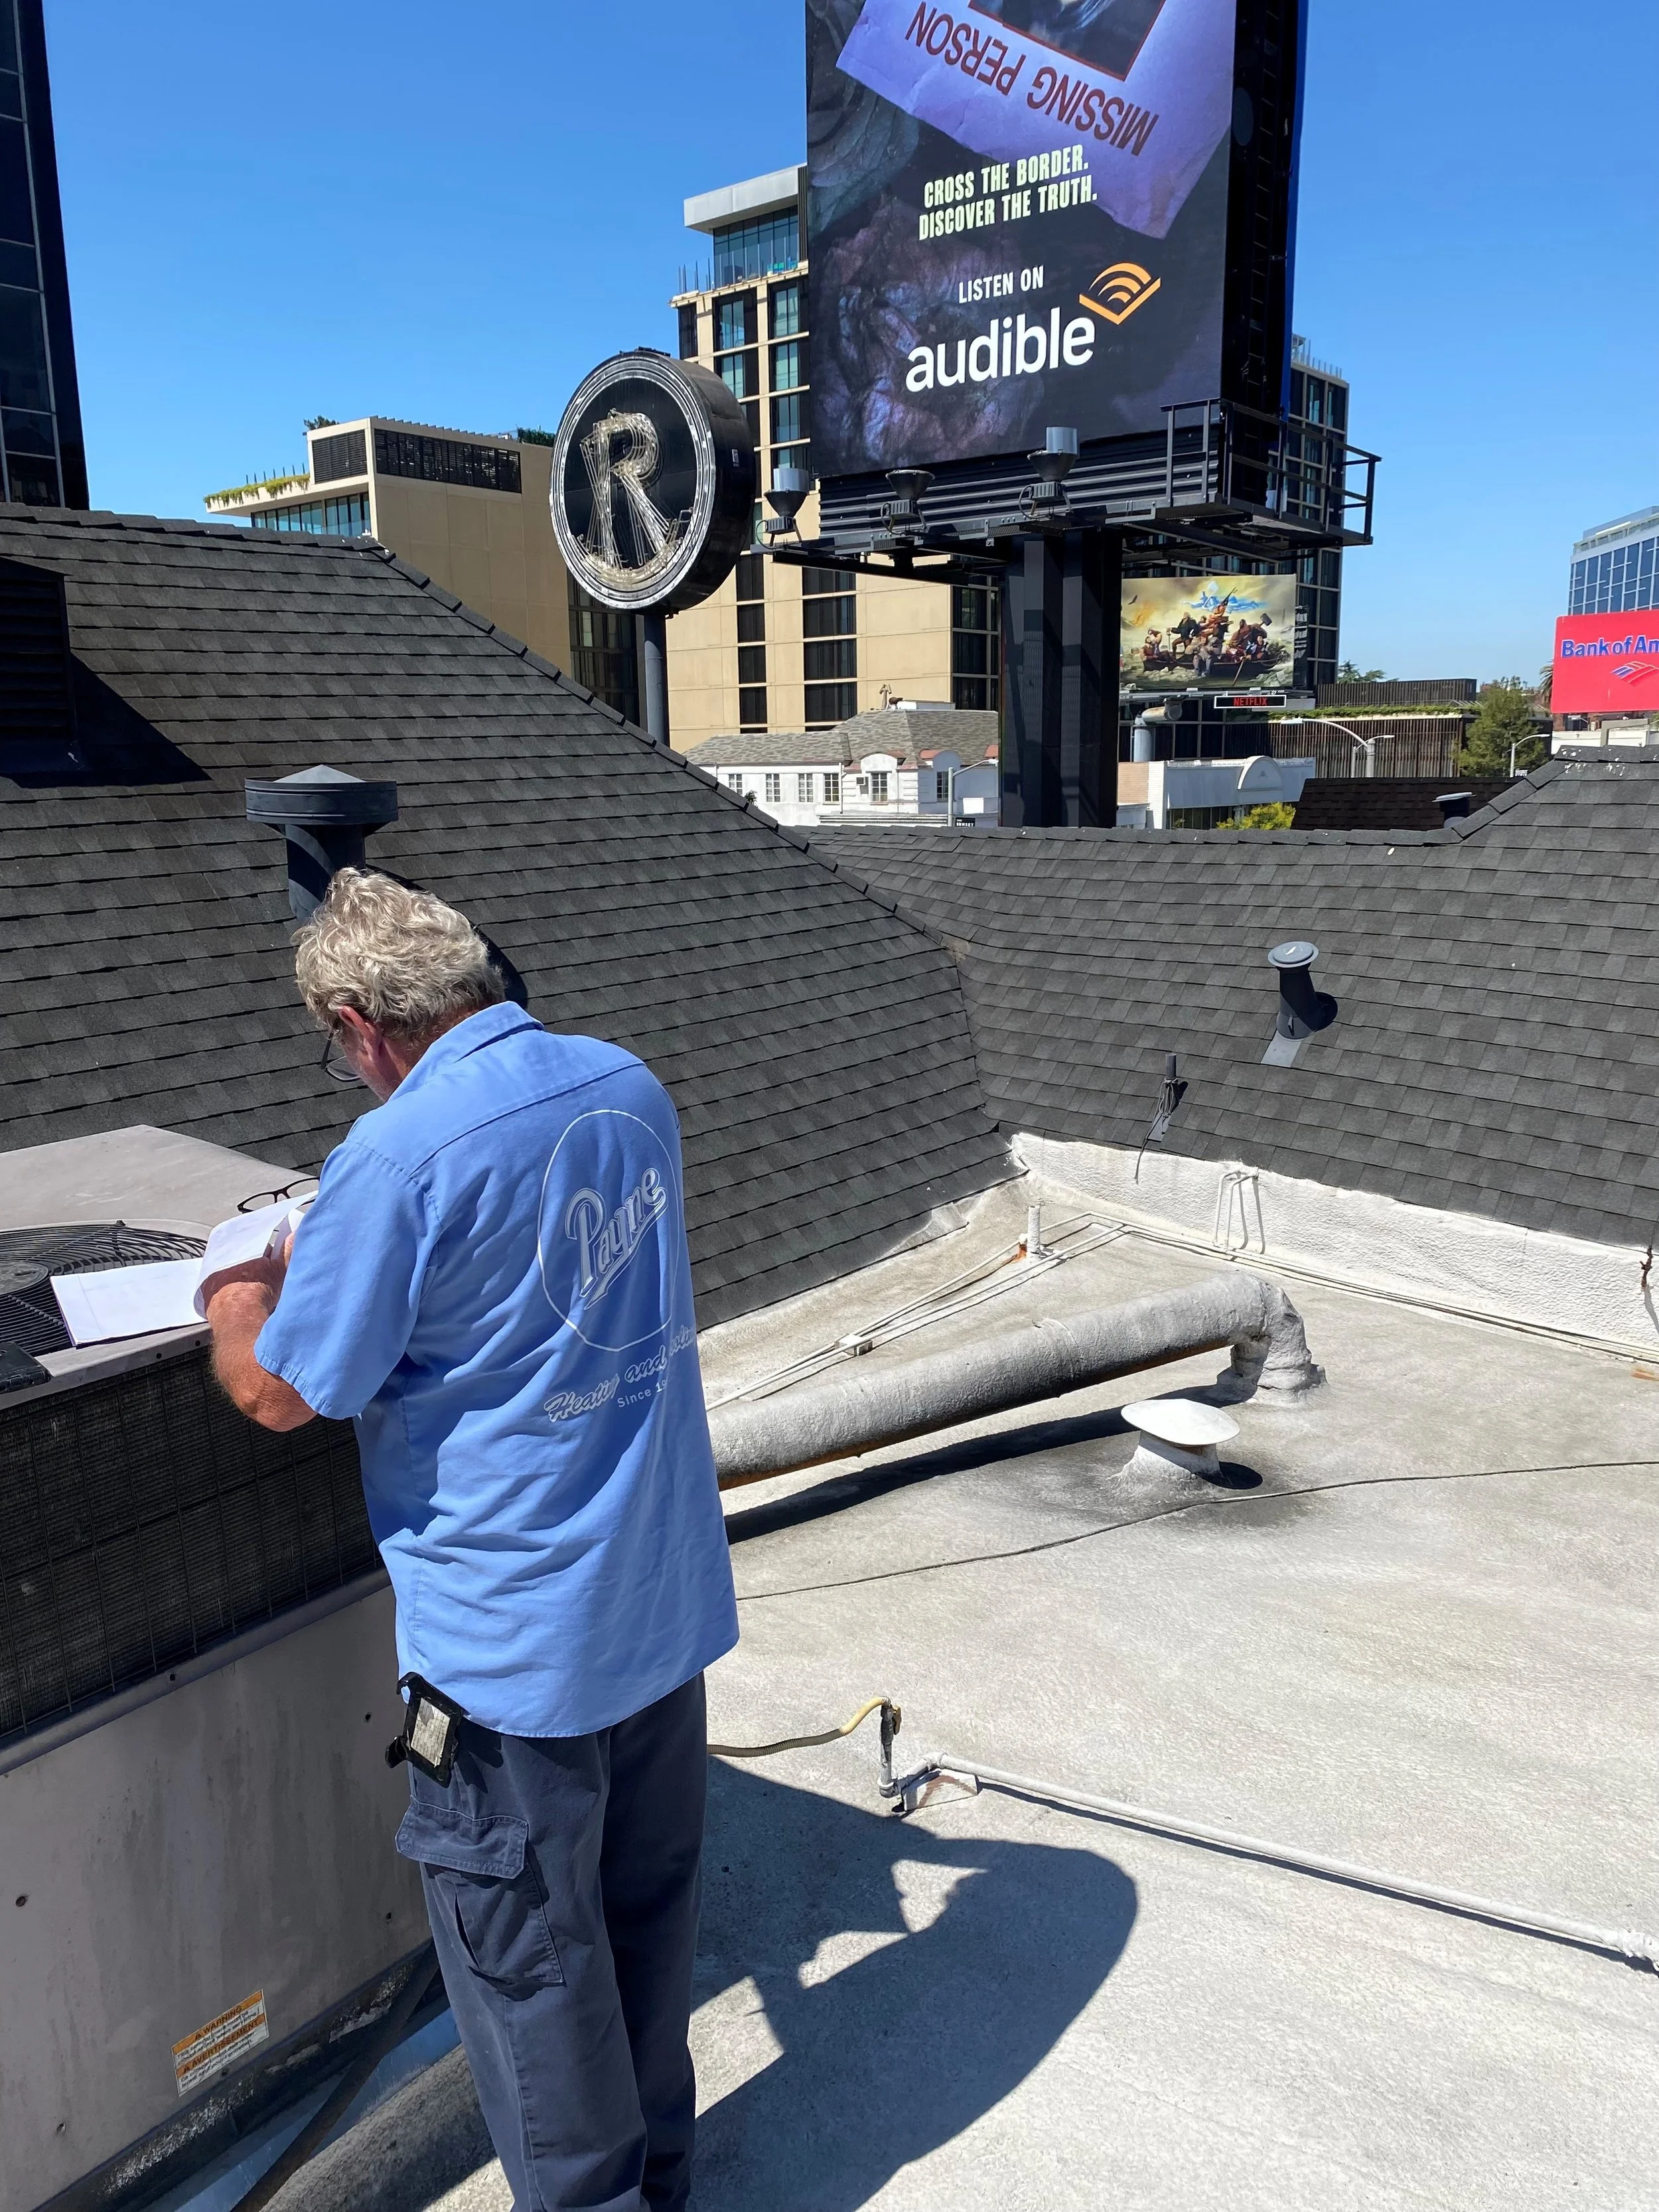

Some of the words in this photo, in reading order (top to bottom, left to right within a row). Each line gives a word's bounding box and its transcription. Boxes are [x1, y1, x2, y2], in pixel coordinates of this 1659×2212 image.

[904, 1, 1027, 96] PERSON
[1027, 66, 1159, 156] MISSING
[918, 198, 995, 241] DISCOVER
[1001, 189, 1031, 222] THE
[1037, 174, 1098, 213] TRUTH.
[924, 171, 975, 208] CROSS
[981, 162, 1010, 194] THE
[1016, 144, 1089, 186] BORDER.
[959, 271, 1013, 304] LISTEN
[1020, 265, 1044, 291] ON
[905, 307, 1095, 392] audible
[579, 408, 672, 569] R
[1561, 637, 1611, 658] Bank
[1612, 635, 1633, 655] of
[1234, 697, 1267, 706] NETFLIX
[565, 1167, 668, 1311] Payne
[543, 1372, 620, 1423] Heati
[624, 1345, 668, 1384] and
[617, 1388, 652, 1408] Since
[191, 2019, 258, 2067] AVERTISSEMENT
[203, 2005, 242, 2033] WARNING
